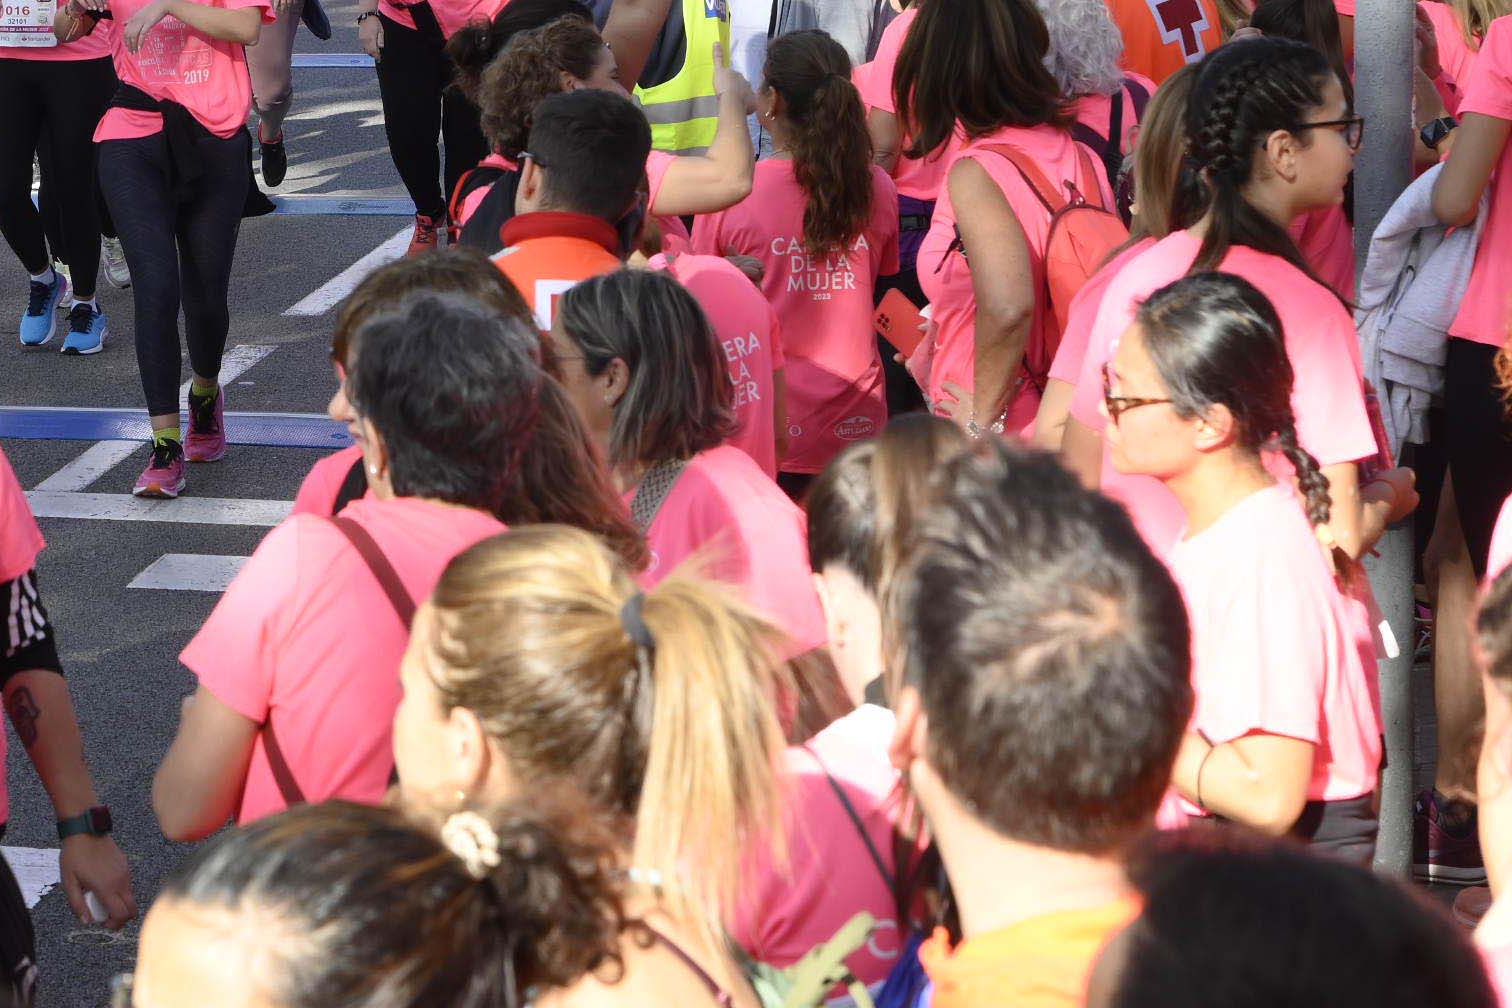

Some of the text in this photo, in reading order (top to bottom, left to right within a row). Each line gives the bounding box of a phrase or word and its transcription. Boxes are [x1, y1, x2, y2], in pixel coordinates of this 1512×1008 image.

[6, 5, 30, 16] 016
[184, 69, 210, 85] 2019
[791, 255, 852, 273] DE LA
[787, 272, 856, 293] MUJER
[729, 361, 751, 386] LA
